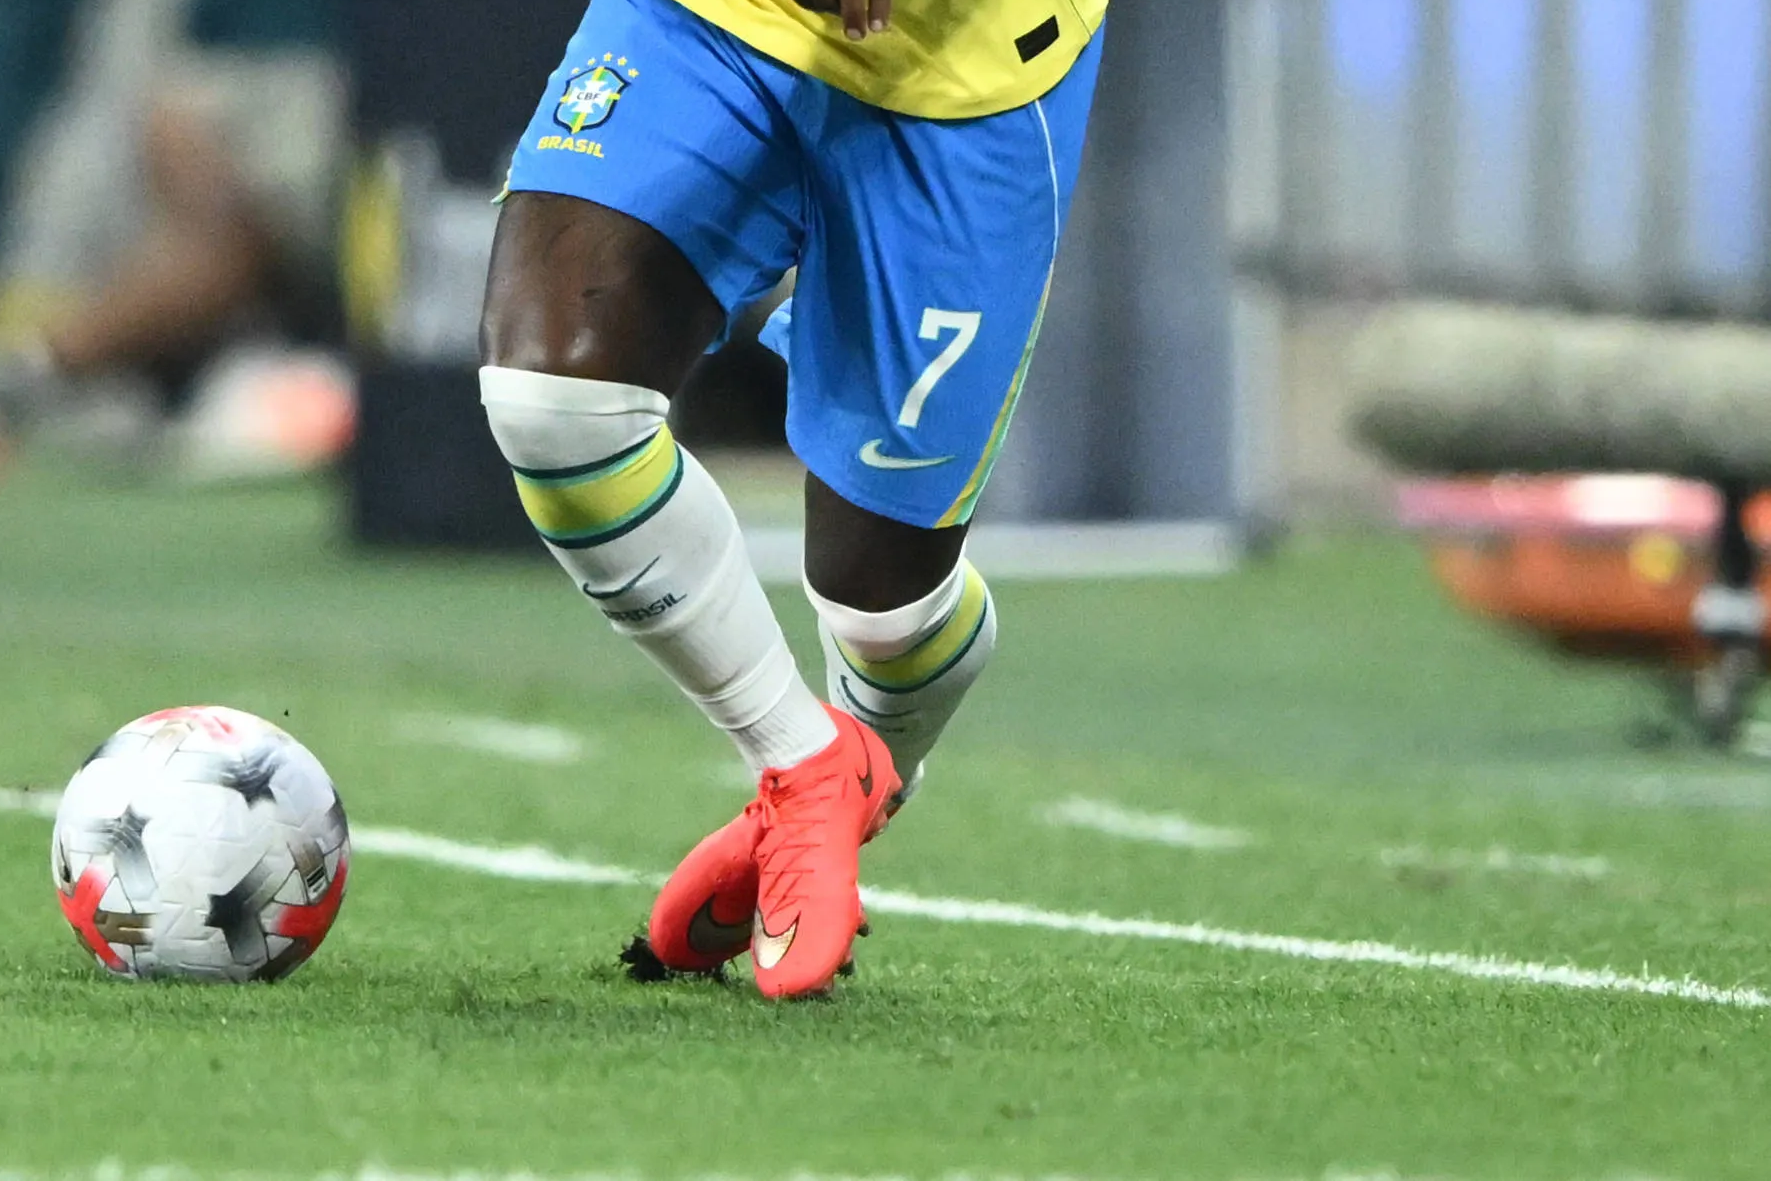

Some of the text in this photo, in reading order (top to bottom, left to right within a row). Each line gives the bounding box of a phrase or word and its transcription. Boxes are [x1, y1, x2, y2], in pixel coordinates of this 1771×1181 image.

[576, 91, 601, 101] CBF
[538, 136, 604, 158] BRASIL
[897, 307, 982, 429] 7
